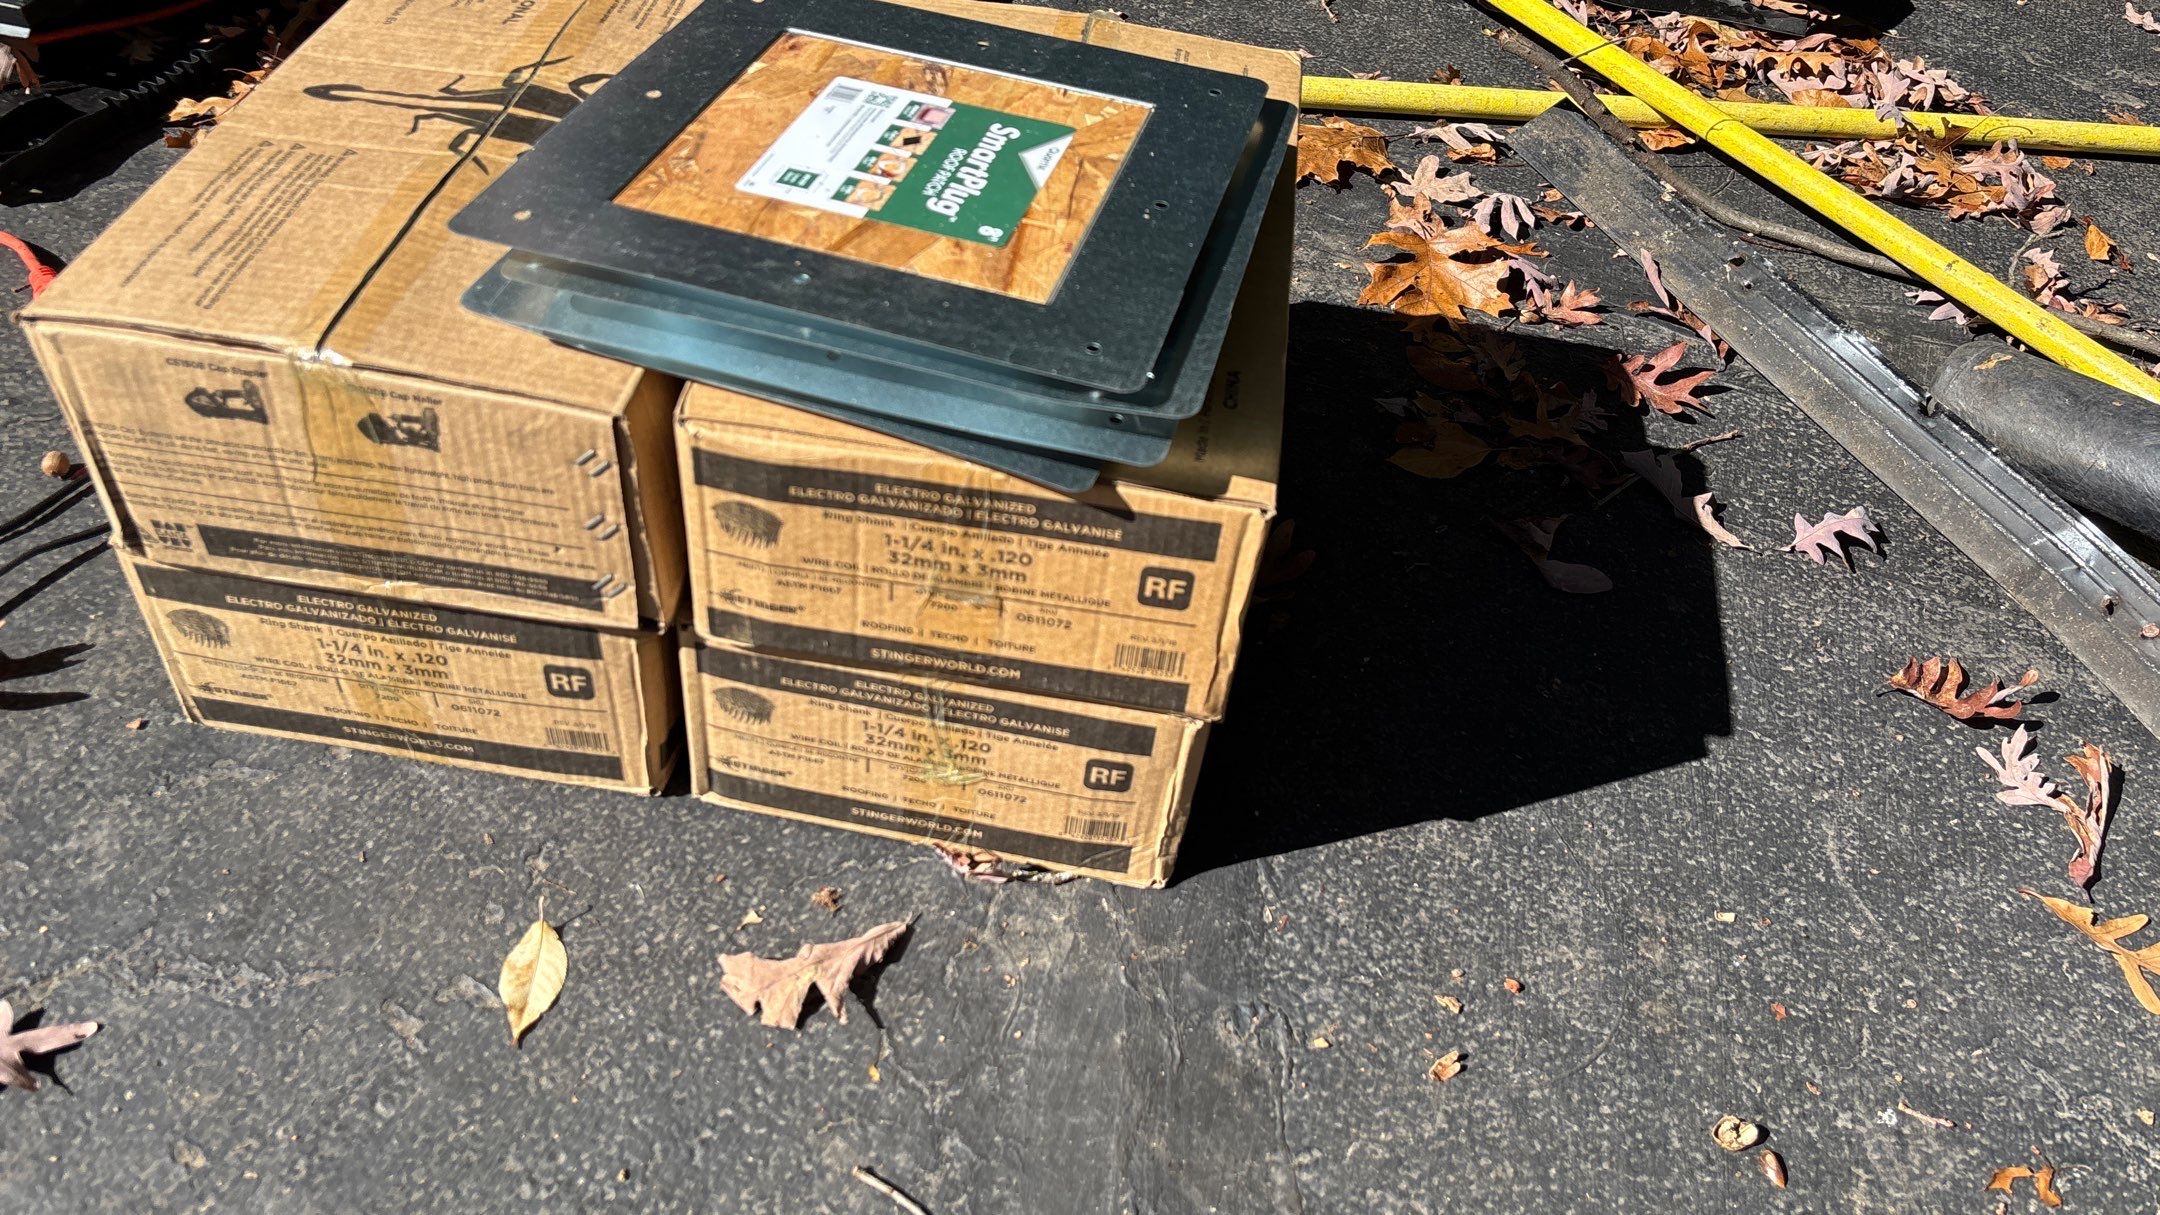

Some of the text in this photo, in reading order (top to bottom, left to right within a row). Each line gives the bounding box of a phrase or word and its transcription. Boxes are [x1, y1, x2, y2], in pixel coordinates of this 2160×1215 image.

[923, 147, 968, 197] ROOF PATCH
[926, 122, 1020, 217] SmartPlug
[389, 390, 409, 404] Cap
[788, 486, 855, 503] ELECTRO
[858, 493, 963, 519] GALVANIZADO
[1042, 518, 1123, 541] GALVANISÉ
[874, 483, 1037, 515] ELECTRO GALVANIZED
[857, 514, 896, 529] Shank
[1027, 538, 1053, 552] Tige
[801, 556, 831, 568] WIRE
[884, 533, 935, 552] 1-1/4
[939, 541, 966, 558] in.
[991, 548, 1032, 566] .120
[887, 551, 952, 572] 32mm
[977, 565, 1027, 582] 3mm
[1143, 576, 1188, 601] RF
[225, 595, 284, 611] ELECTRO
[285, 603, 376, 626] GALVANIZADO
[446, 626, 518, 645] GALVANISÉ
[297, 595, 437, 622] ELECTRO GALVANIZED
[260, 618, 287, 630] Ring
[289, 620, 323, 634] Shank
[438, 642, 463, 654] Tige
[862, 620, 914, 635] ROOFING
[988, 639, 1036, 654] TOITURE
[255, 656, 281, 666] WIRE
[283, 659, 306, 670] COIL
[317, 638, 448, 666] 1-1/4 in. x .120
[325, 652, 449, 680] 32mm x 3mm
[870, 648, 1021, 679] STINGERWORLD.COM
[549, 672, 588, 692] RF
[854, 680, 994, 713] ELECTRO GALVANIZED
[323, 706, 371, 718] ROOFING
[435, 723, 479, 735] TOITURE
[780, 677, 838, 694] ELECTRO
[840, 685, 930, 711] GALVANIZADO
[999, 716, 1071, 738] GALVANISÉ
[838, 703, 873, 717] Shank
[986, 731, 1010, 743] Tige
[342, 726, 475, 753] STINGERWORLD.COM
[791, 733, 817, 744] WIRE
[862, 720, 905, 739] 1-1/4
[911, 728, 933, 745] in.
[955, 738, 992, 753] .120
[865, 733, 921, 754] 32mm
[946, 748, 987, 765] 3mm
[1089, 767, 1128, 785] RF
[842, 785, 889, 799] ROOFING
[953, 806, 996, 820] TOITURE
[978, 788, 1027, 804] 0611072
[850, 807, 983, 838] STINGERWORLD.COM
